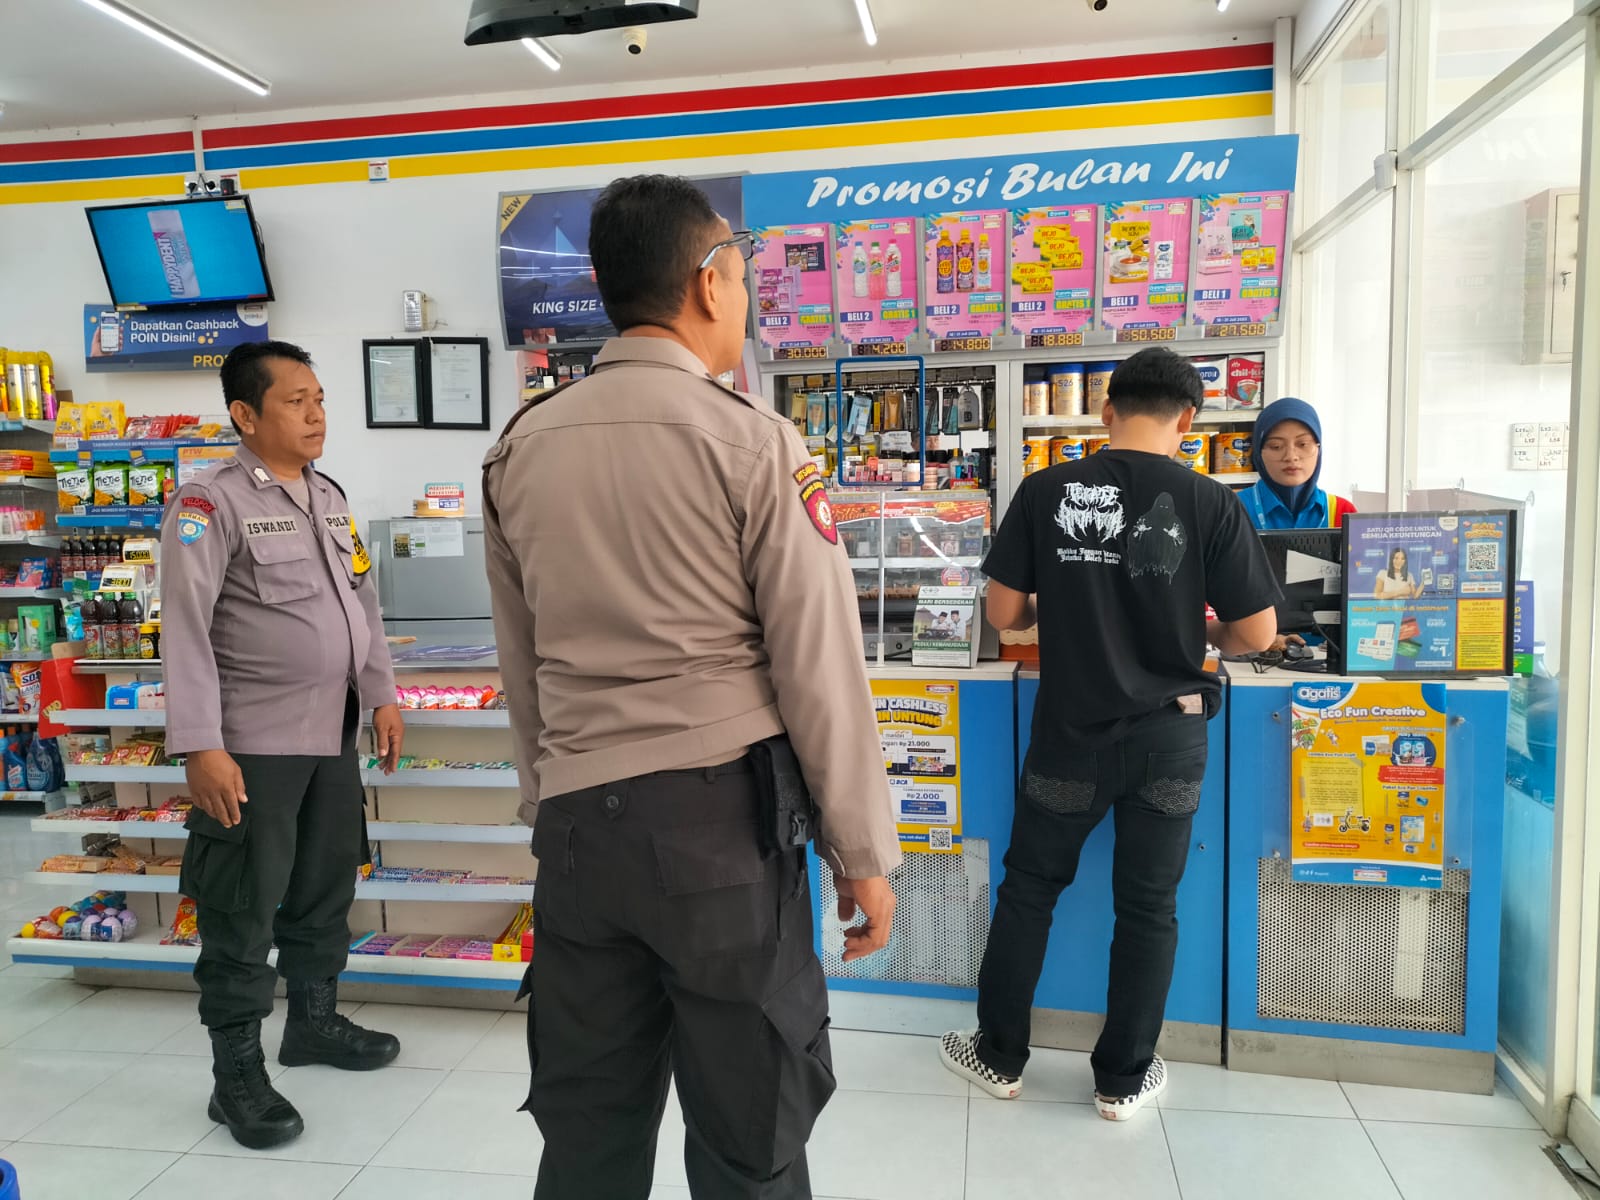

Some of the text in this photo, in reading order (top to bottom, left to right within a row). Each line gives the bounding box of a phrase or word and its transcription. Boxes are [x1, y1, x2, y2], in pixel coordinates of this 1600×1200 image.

[807, 149, 1234, 208] Promosi Bulan Ini
[500, 196, 521, 221] NEW
[155, 237, 186, 296] HAPPYDENT
[532, 299, 597, 314] KING SIZE
[1036, 302, 1042, 310] 2
[1110, 296, 1134, 306] BELI 1
[847, 311, 870, 321] BELI 2
[933, 305, 957, 315] BELI 2
[782, 316, 788, 325] 2
[130, 320, 240, 335] Dapatkan Cashback
[1131, 328, 1176, 340] 50.500
[130, 333, 196, 343] POIN Disini!
[787, 347, 827, 359] 30.000
[193, 355, 227, 368] PRO
[247, 521, 296, 535] ISWANDI
[888, 698, 947, 715] CASHLESS
[1320, 705, 1427, 719] Eco Fun Creative
[892, 711, 942, 727] UNTUNG
